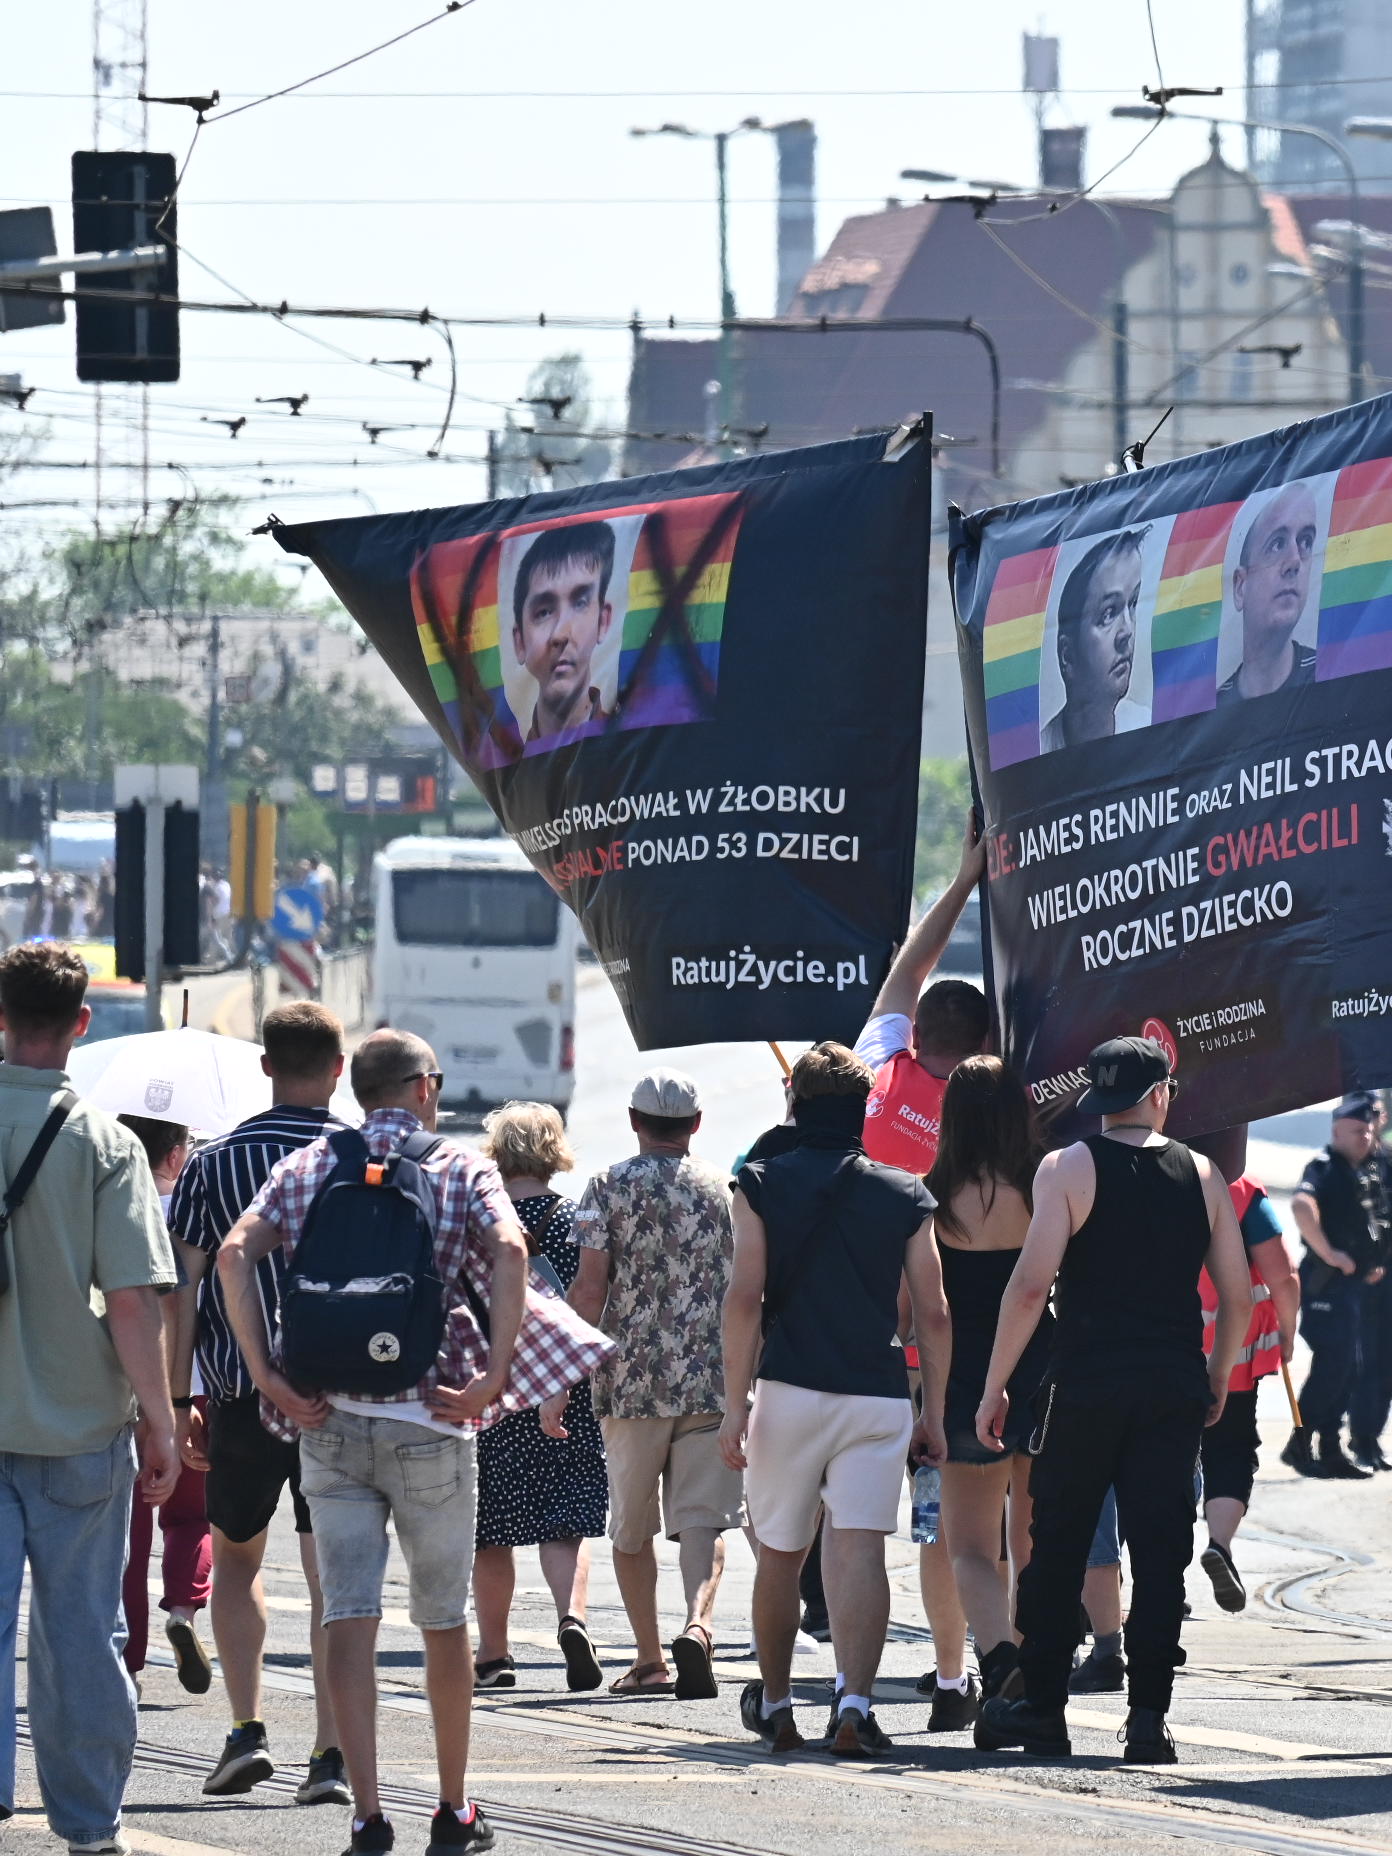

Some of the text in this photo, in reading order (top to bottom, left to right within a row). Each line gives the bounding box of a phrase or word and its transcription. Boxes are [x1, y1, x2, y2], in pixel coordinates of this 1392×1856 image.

[573, 790, 681, 833] PRACOWAŁ
[686, 787, 715, 815] W
[718, 780, 847, 815] ŻŁOBKU
[1019, 813, 1084, 869] JAMES
[1090, 787, 1180, 845] RENNIE
[1185, 783, 1232, 819] ORAZ
[1239, 758, 1298, 804] NEIL
[628, 834, 709, 868] PONAD
[716, 832, 748, 859] 53
[757, 832, 860, 863] DZIECI
[1028, 803, 1360, 930] WIELOKROTNIE GWAŁCILI
[1081, 880, 1294, 972] ROCZNE DZIECKO
[671, 945, 869, 991] RatujŻycie.pl
[1176, 1013, 1212, 1038] ŻYCIE
[1217, 998, 1266, 1027] RODZINA
[1199, 1027, 1256, 1054] FUNDACJA
[1030, 1066, 1093, 1105] DEWIAC
